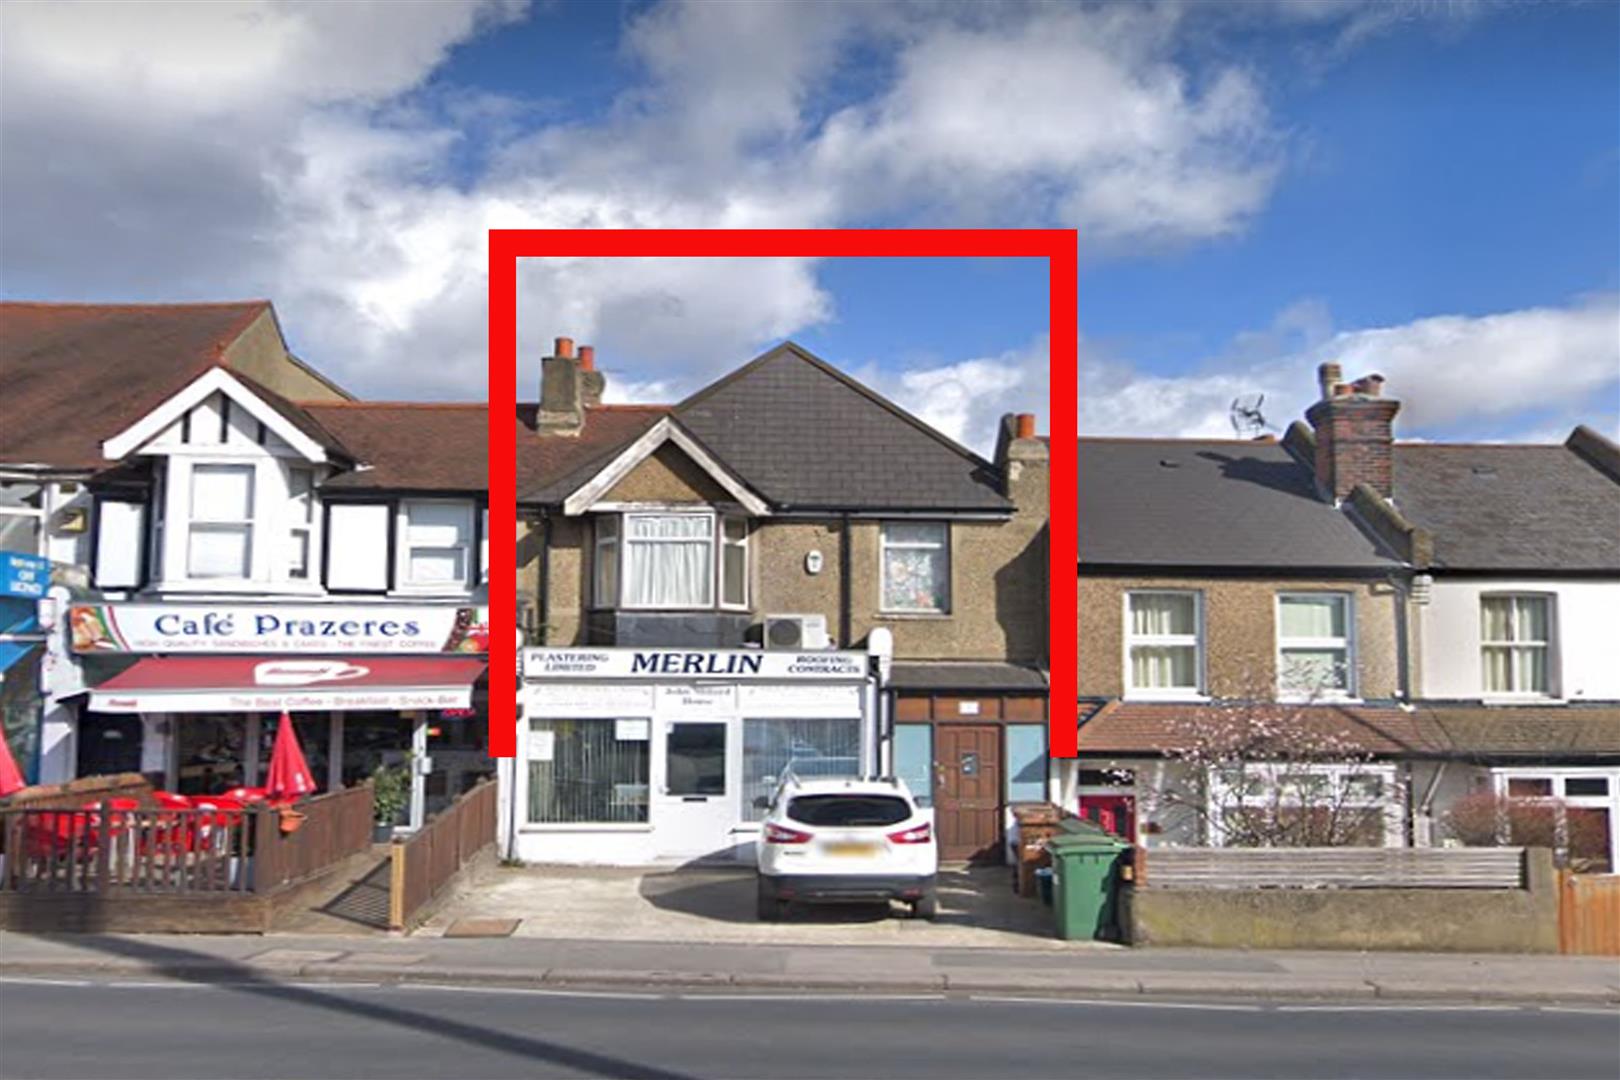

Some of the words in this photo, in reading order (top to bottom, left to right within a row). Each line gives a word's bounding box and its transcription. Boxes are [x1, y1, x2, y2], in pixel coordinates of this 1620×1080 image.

[154, 612, 234, 636] Café
[255, 614, 420, 636] Prazeres
[163, 640, 206, 648] QUALITY
[360, 640, 393, 648] FINEST
[400, 640, 436, 648] COFFEE
[530, 652, 609, 663] PLASTERING
[796, 655, 853, 664] ROOFING
[544, 662, 596, 672] LIMITED
[631, 652, 763, 674] MERLIN
[788, 664, 860, 674] CONTRACTS
[229, 696, 251, 707] The
[255, 696, 282, 706] Best
[285, 695, 323, 706] Coffee
[334, 695, 390, 706] Breakfast
